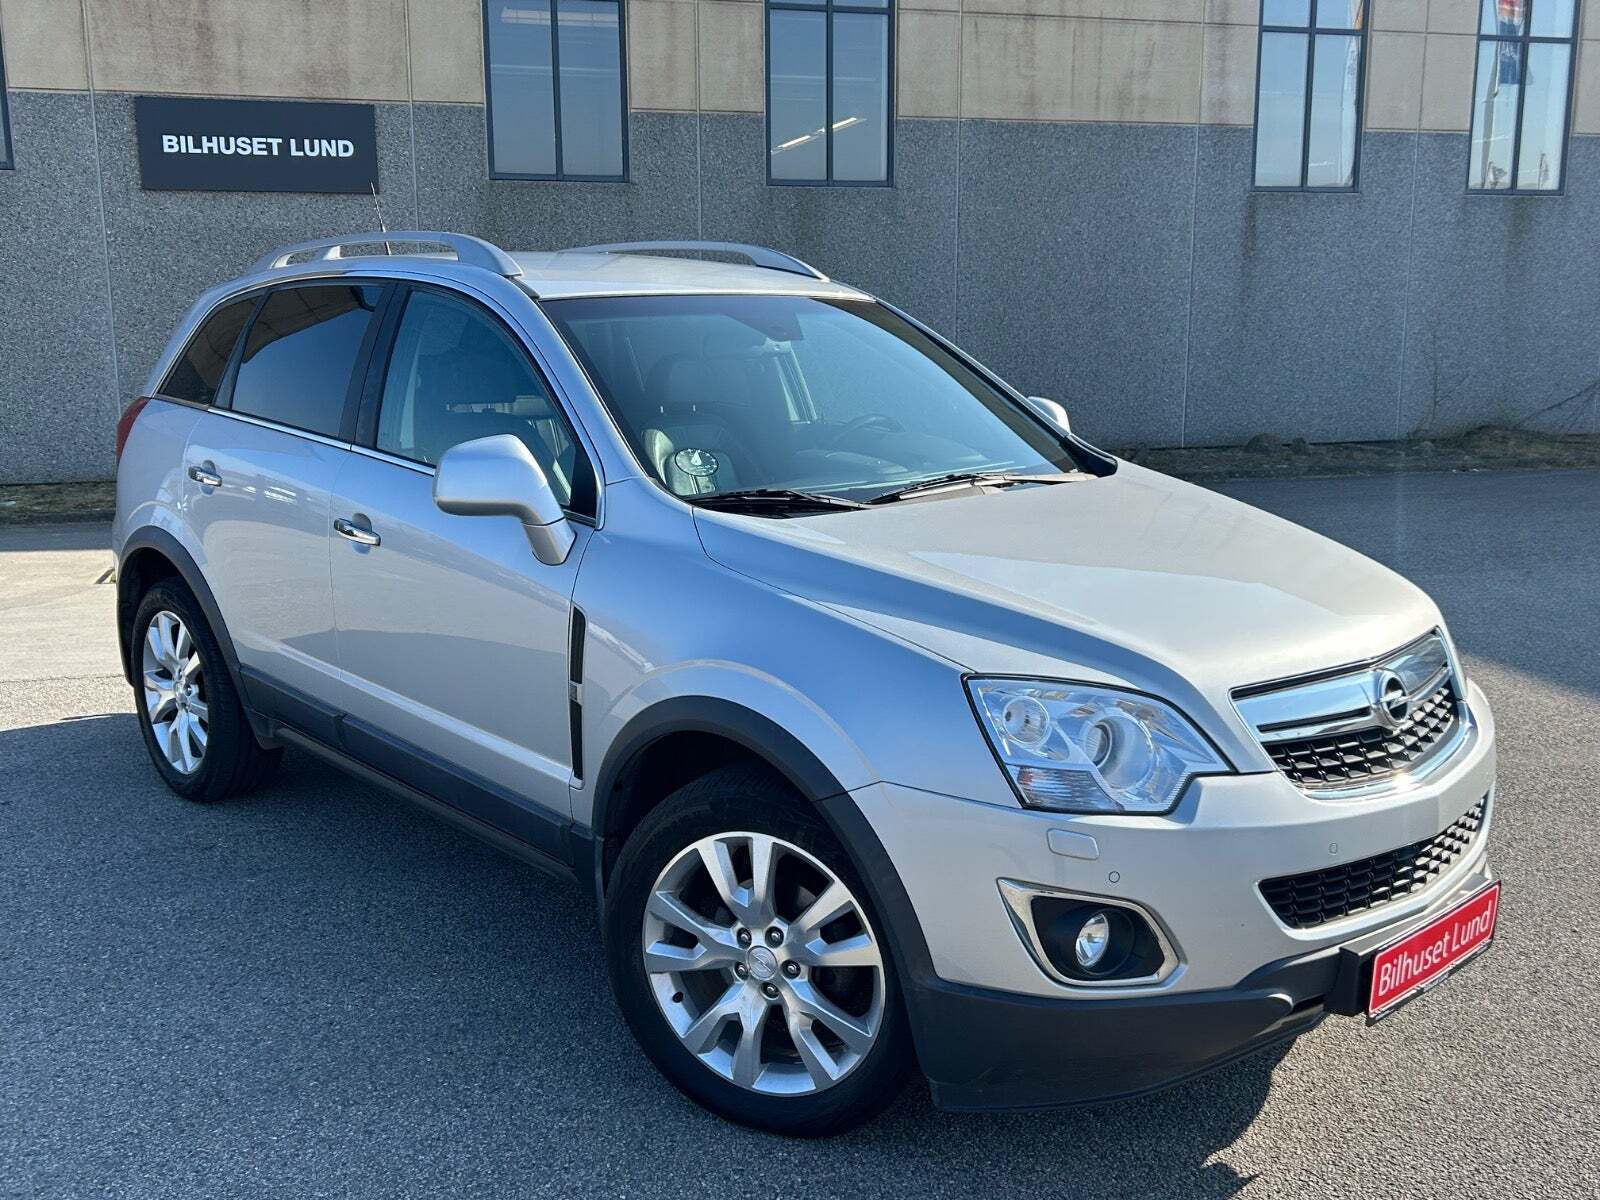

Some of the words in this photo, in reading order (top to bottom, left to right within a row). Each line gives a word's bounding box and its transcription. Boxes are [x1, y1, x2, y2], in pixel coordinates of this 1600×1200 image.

[162, 135, 282, 156] BILHUSET
[290, 138, 354, 157] LUND
[1378, 932, 1451, 997] Bilhuset
[1451, 899, 1493, 952] Lund
